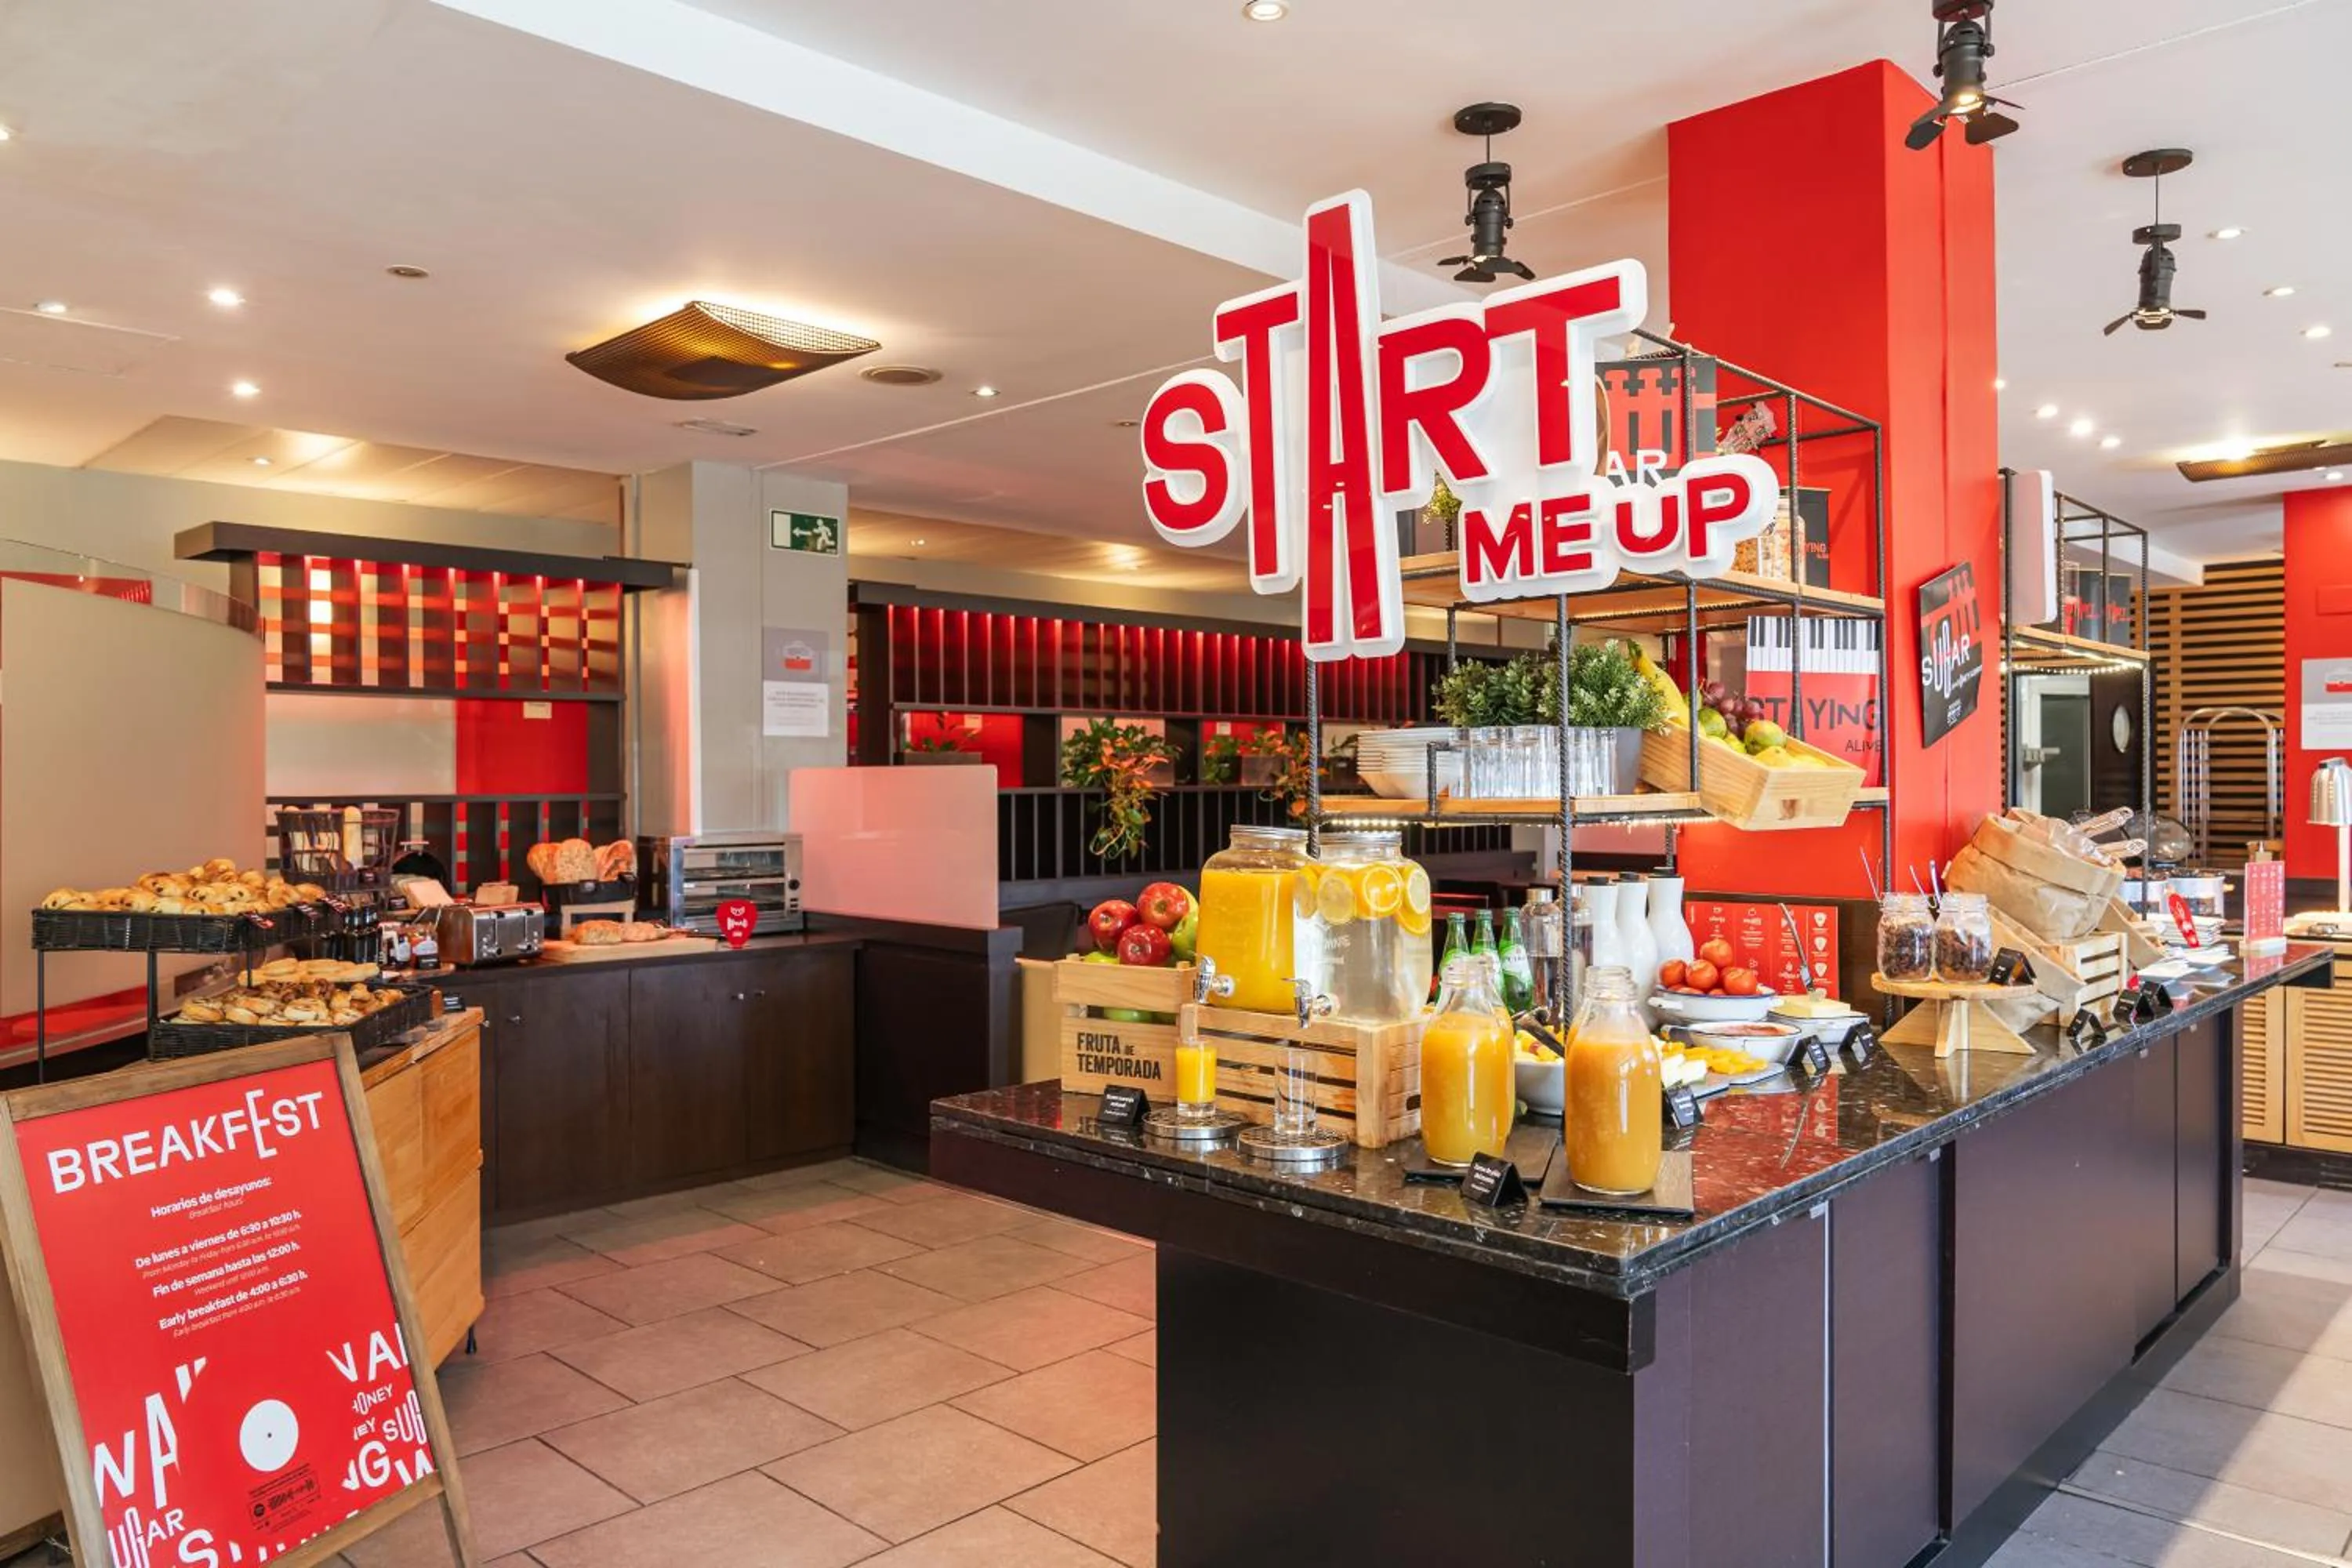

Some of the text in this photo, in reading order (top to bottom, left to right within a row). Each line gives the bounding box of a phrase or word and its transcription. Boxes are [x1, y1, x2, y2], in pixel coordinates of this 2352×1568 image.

[1144, 205, 1620, 644] START
[1465, 473, 1751, 584] ME UP
[1922, 619, 1970, 699] SUGAR
[1076, 1032, 1135, 1056] FRUTA DE
[1076, 1053, 1162, 1080] TEMPORADA
[46, 1089, 323, 1194] BREAKFEST
[151, 1197, 198, 1217] Horarios
[199, 1192, 212, 1204] de
[135, 1258, 151, 1269] De
[151, 1249, 180, 1264] lunes
[182, 1246, 188, 1254] a
[189, 1233, 226, 1252] viernes
[227, 1229, 239, 1240] de
[263, 1220, 268, 1229] a
[153, 1285, 170, 1298] Fin
[171, 1279, 185, 1291] de
[185, 1266, 225, 1286] semana
[225, 1257, 252, 1274] hasta
[252, 1251, 267, 1264] las
[159, 1311, 187, 1330] Early
[187, 1295, 236, 1319] breakfast
[236, 1290, 249, 1303] de
[249, 1283, 270, 1298] 4:00
[271, 1279, 278, 1290] a
